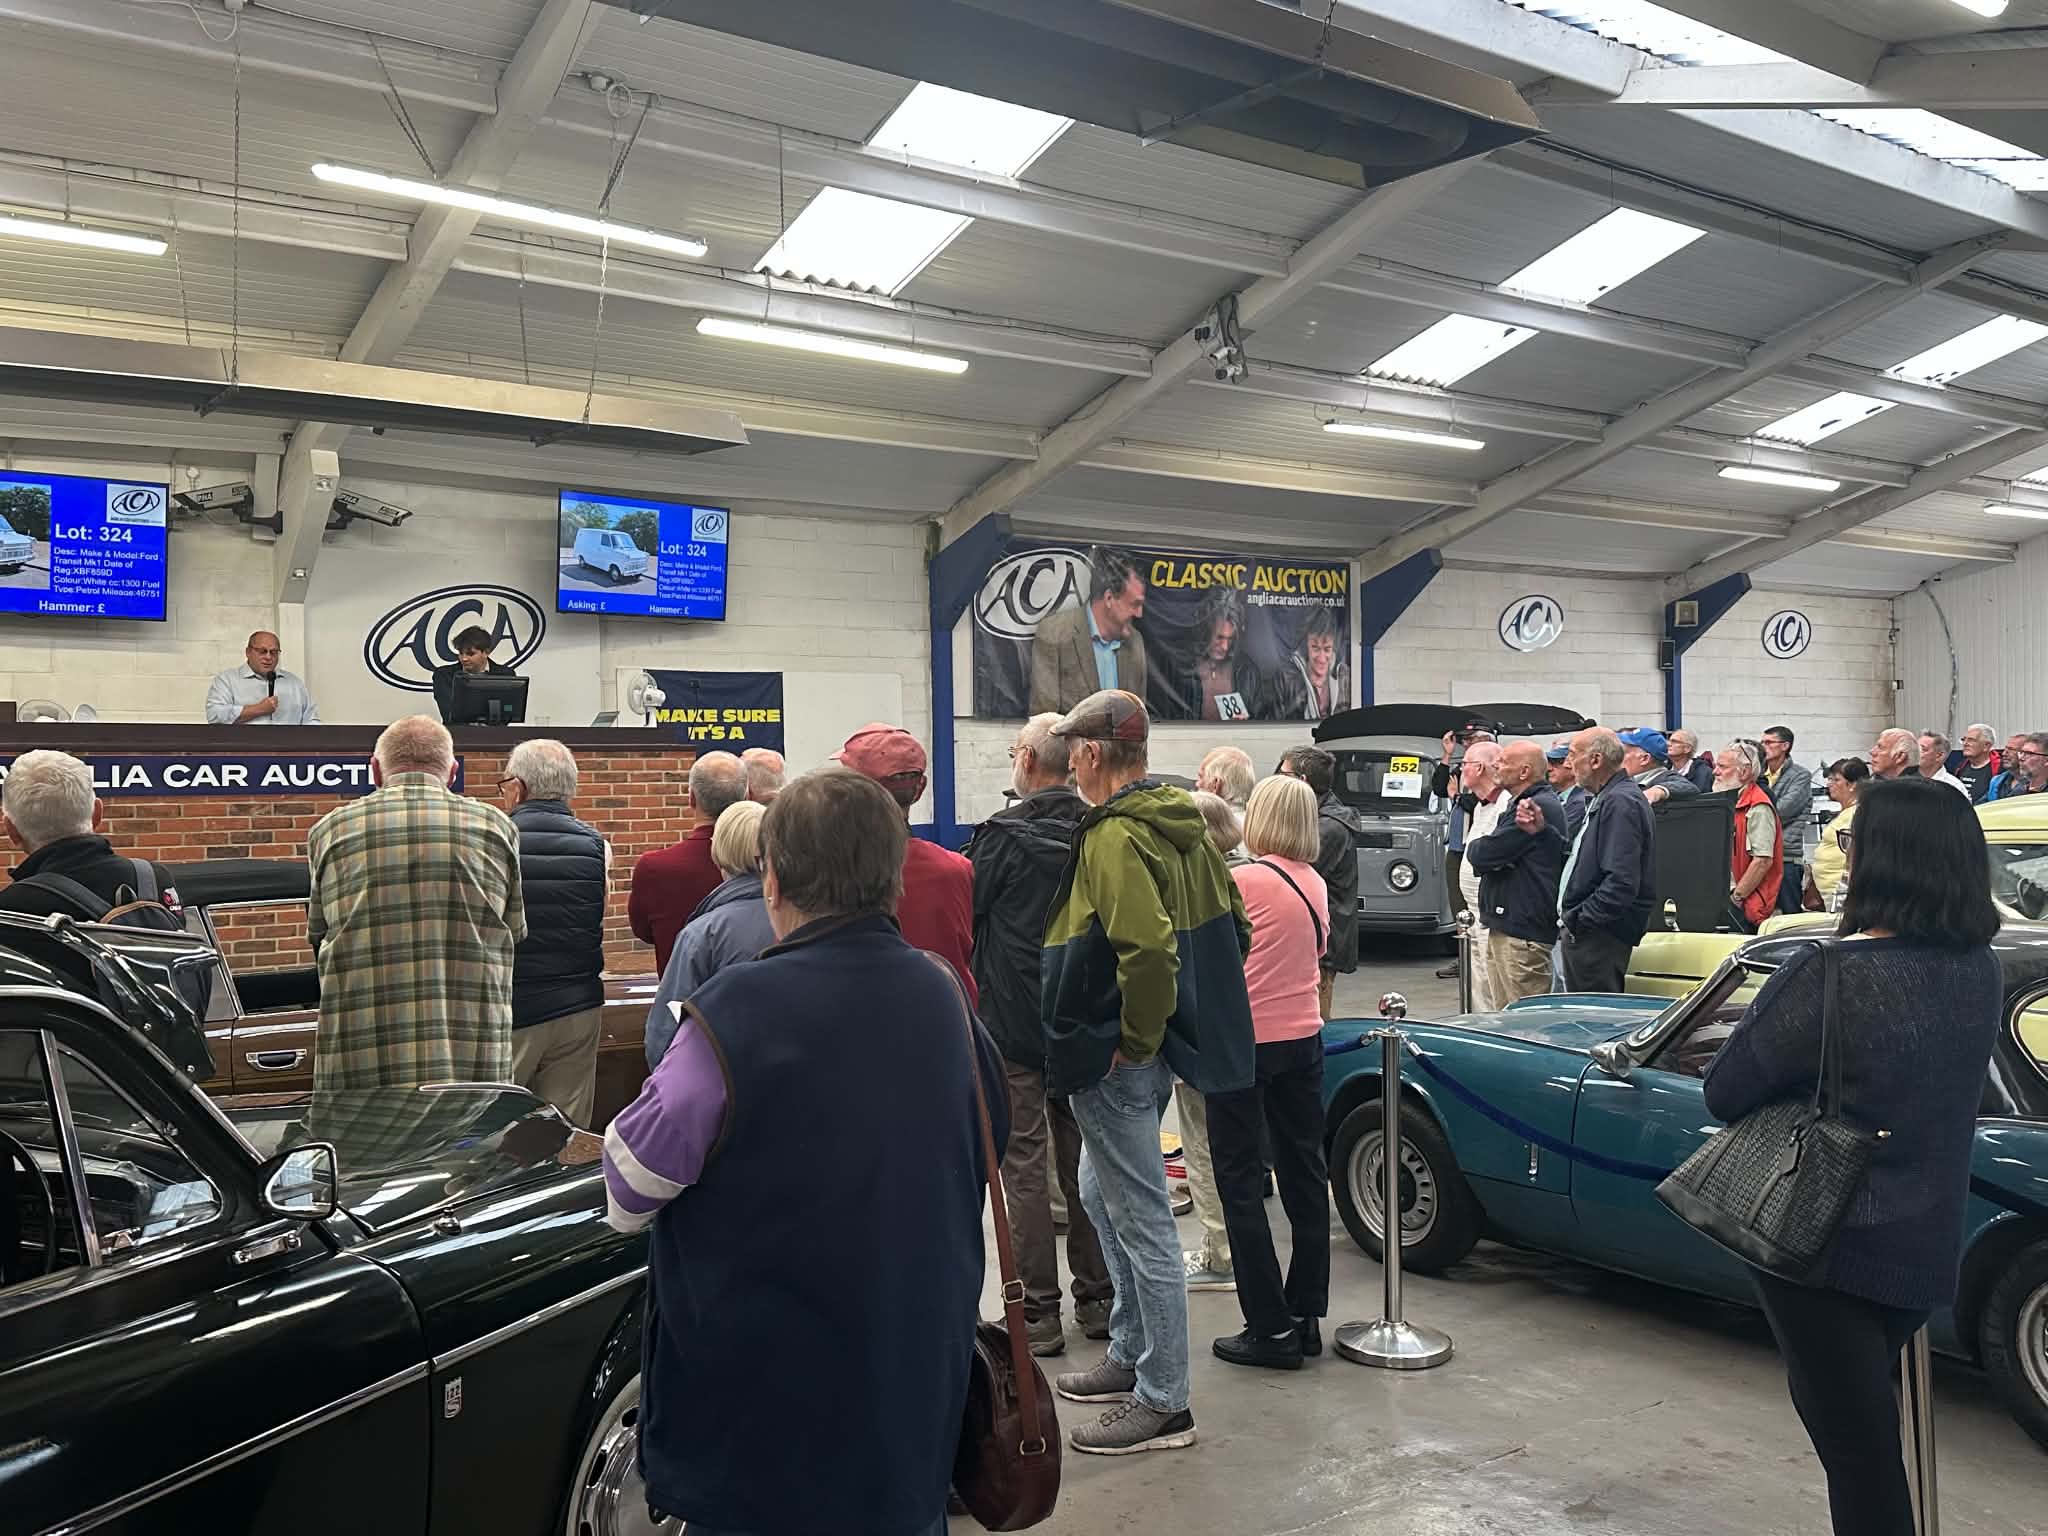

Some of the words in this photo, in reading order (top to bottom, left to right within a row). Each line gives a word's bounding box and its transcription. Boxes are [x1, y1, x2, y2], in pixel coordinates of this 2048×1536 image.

[114, 492, 154, 512] ACA
[55, 523, 93, 540] Lot:
[99, 526, 133, 543] 324
[80, 548, 103, 557] Make
[104, 550, 111, 558] &
[660, 541, 683, 556] Lot:
[687, 544, 707, 558] 324
[54, 556, 82, 565] Transit
[84, 557, 100, 566] Mk1
[103, 559, 123, 568] Date
[124, 560, 134, 568] of
[142, 580, 160, 589] Fuel
[1151, 560, 1247, 590] CLASSIC
[1252, 565, 1347, 593] AUCTION
[982, 558, 1084, 625] ACA
[39, 600, 94, 613] Hammer:
[97, 603, 105, 613] £
[567, 600, 599, 611] Asking:
[600, 601, 607, 610] £
[649, 605, 683, 615] Hammer:
[684, 606, 690, 615] £
[1504, 601, 1554, 643] ACA
[384, 599, 521, 671] ACA
[1766, 616, 1804, 652] ACA
[656, 709, 718, 722] MAKE
[722, 709, 781, 722] SURE
[1222, 696, 1241, 718] 88
[688, 724, 725, 740] IT'S
[728, 726, 745, 739] A
[163, 764, 248, 788] CAR
[1391, 762, 1418, 773] 552
